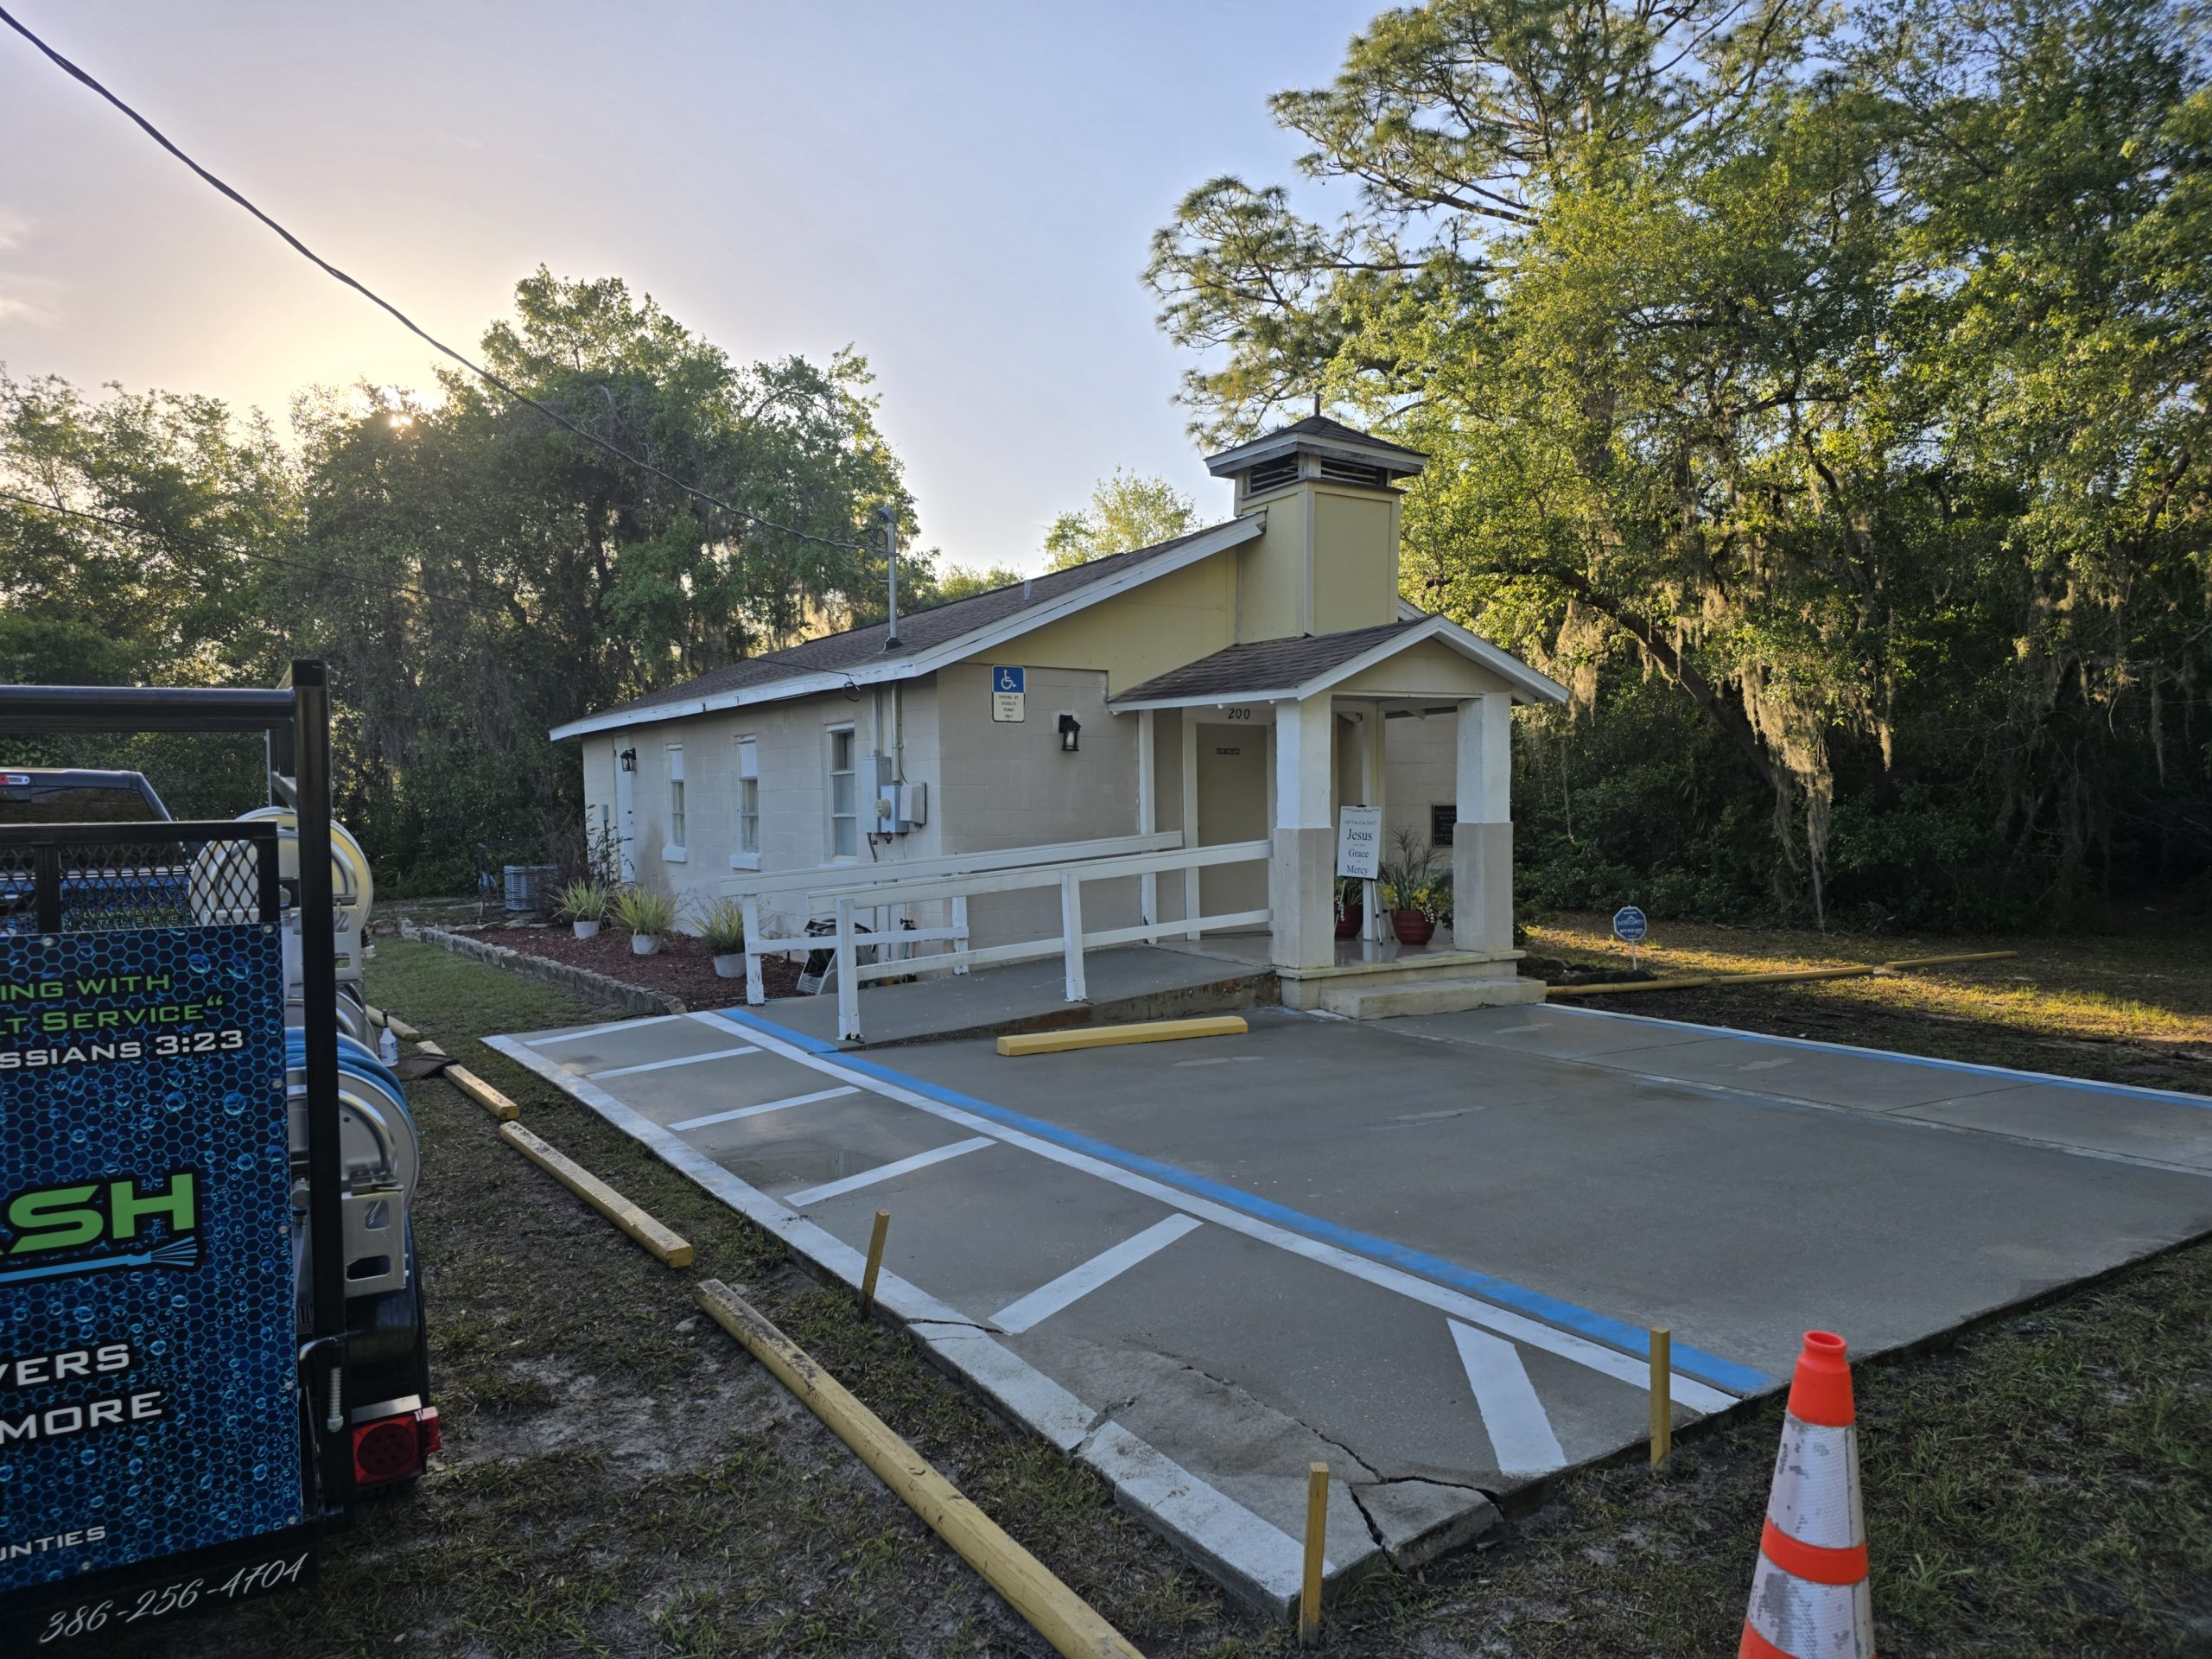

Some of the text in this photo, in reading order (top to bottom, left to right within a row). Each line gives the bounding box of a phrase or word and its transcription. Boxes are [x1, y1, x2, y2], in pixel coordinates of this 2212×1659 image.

[1228, 709, 1250, 719] 200
[1346, 829, 1373, 842] Jesus
[1348, 849, 1370, 858] Grace
[1346, 864, 1369, 876] Mercy
[1, 974, 169, 1001] ING WITH
[0, 1017, 29, 1035] T
[0, 1029, 244, 1069] SSIANS 3:23
[0, 1173, 195, 1254] SH
[0, 1390, 163, 1445] MORE
[39, 1552, 309, 1643] 386-256-4704
